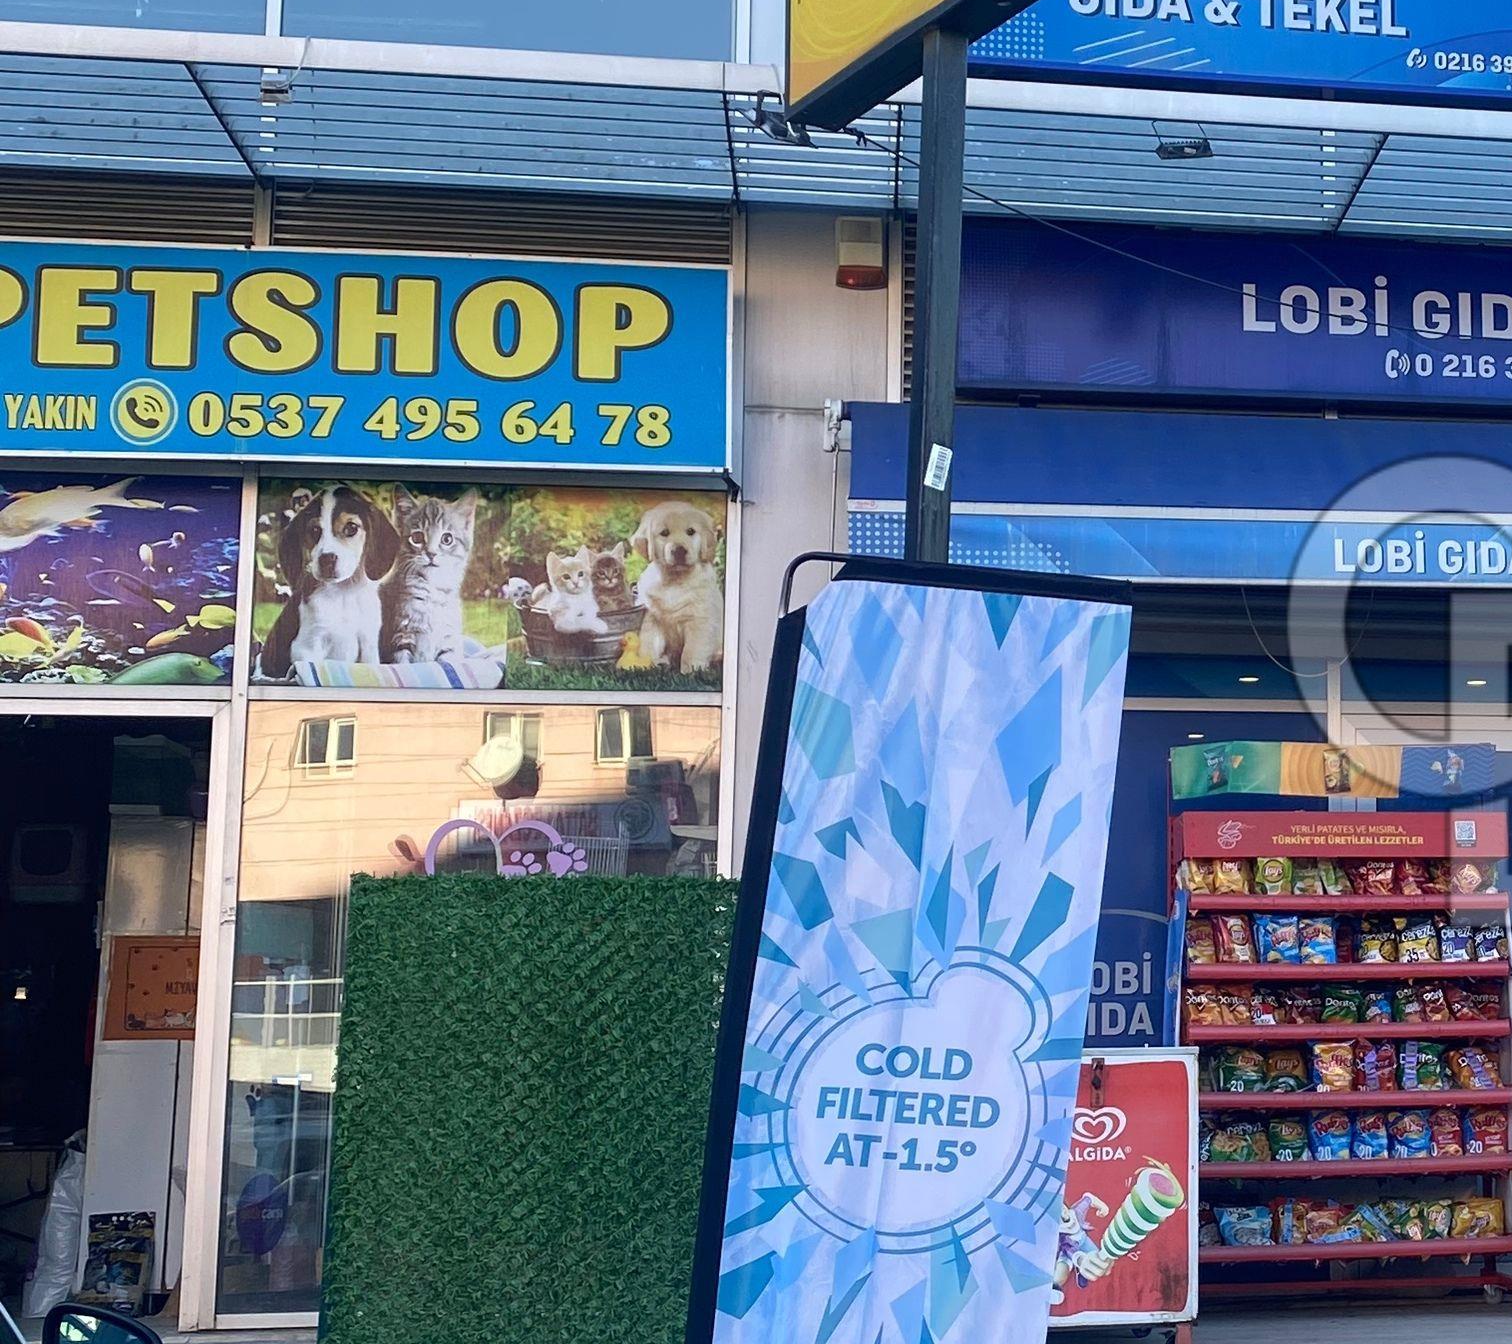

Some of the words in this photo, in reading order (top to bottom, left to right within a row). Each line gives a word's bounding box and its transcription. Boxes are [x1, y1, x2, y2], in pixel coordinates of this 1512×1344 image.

[1434, 51, 1485, 74] 0216
[0, 263, 673, 383] ETSHOP
[1415, 354, 1434, 377] 0
[1442, 354, 1496, 378] 216
[4, 393, 97, 431] YAKIN
[188, 392, 345, 439] 0537
[363, 396, 481, 443] 495
[500, 400, 575, 446] 64
[597, 403, 673, 448] 78
[1317, 825, 1354, 834] PATATES
[1375, 836, 1424, 845] LEZZETLER
[1405, 948, 1420, 963] 35
[856, 1043, 973, 1081] COLD
[1231, 1081, 1244, 1093] 20
[816, 1086, 1000, 1129] FILTERED
[1318, 1146, 1332, 1160] 20
[1359, 1146, 1373, 1159] 20
[1469, 1140, 1483, 1154] 20
[1279, 1149, 1293, 1161] 20
